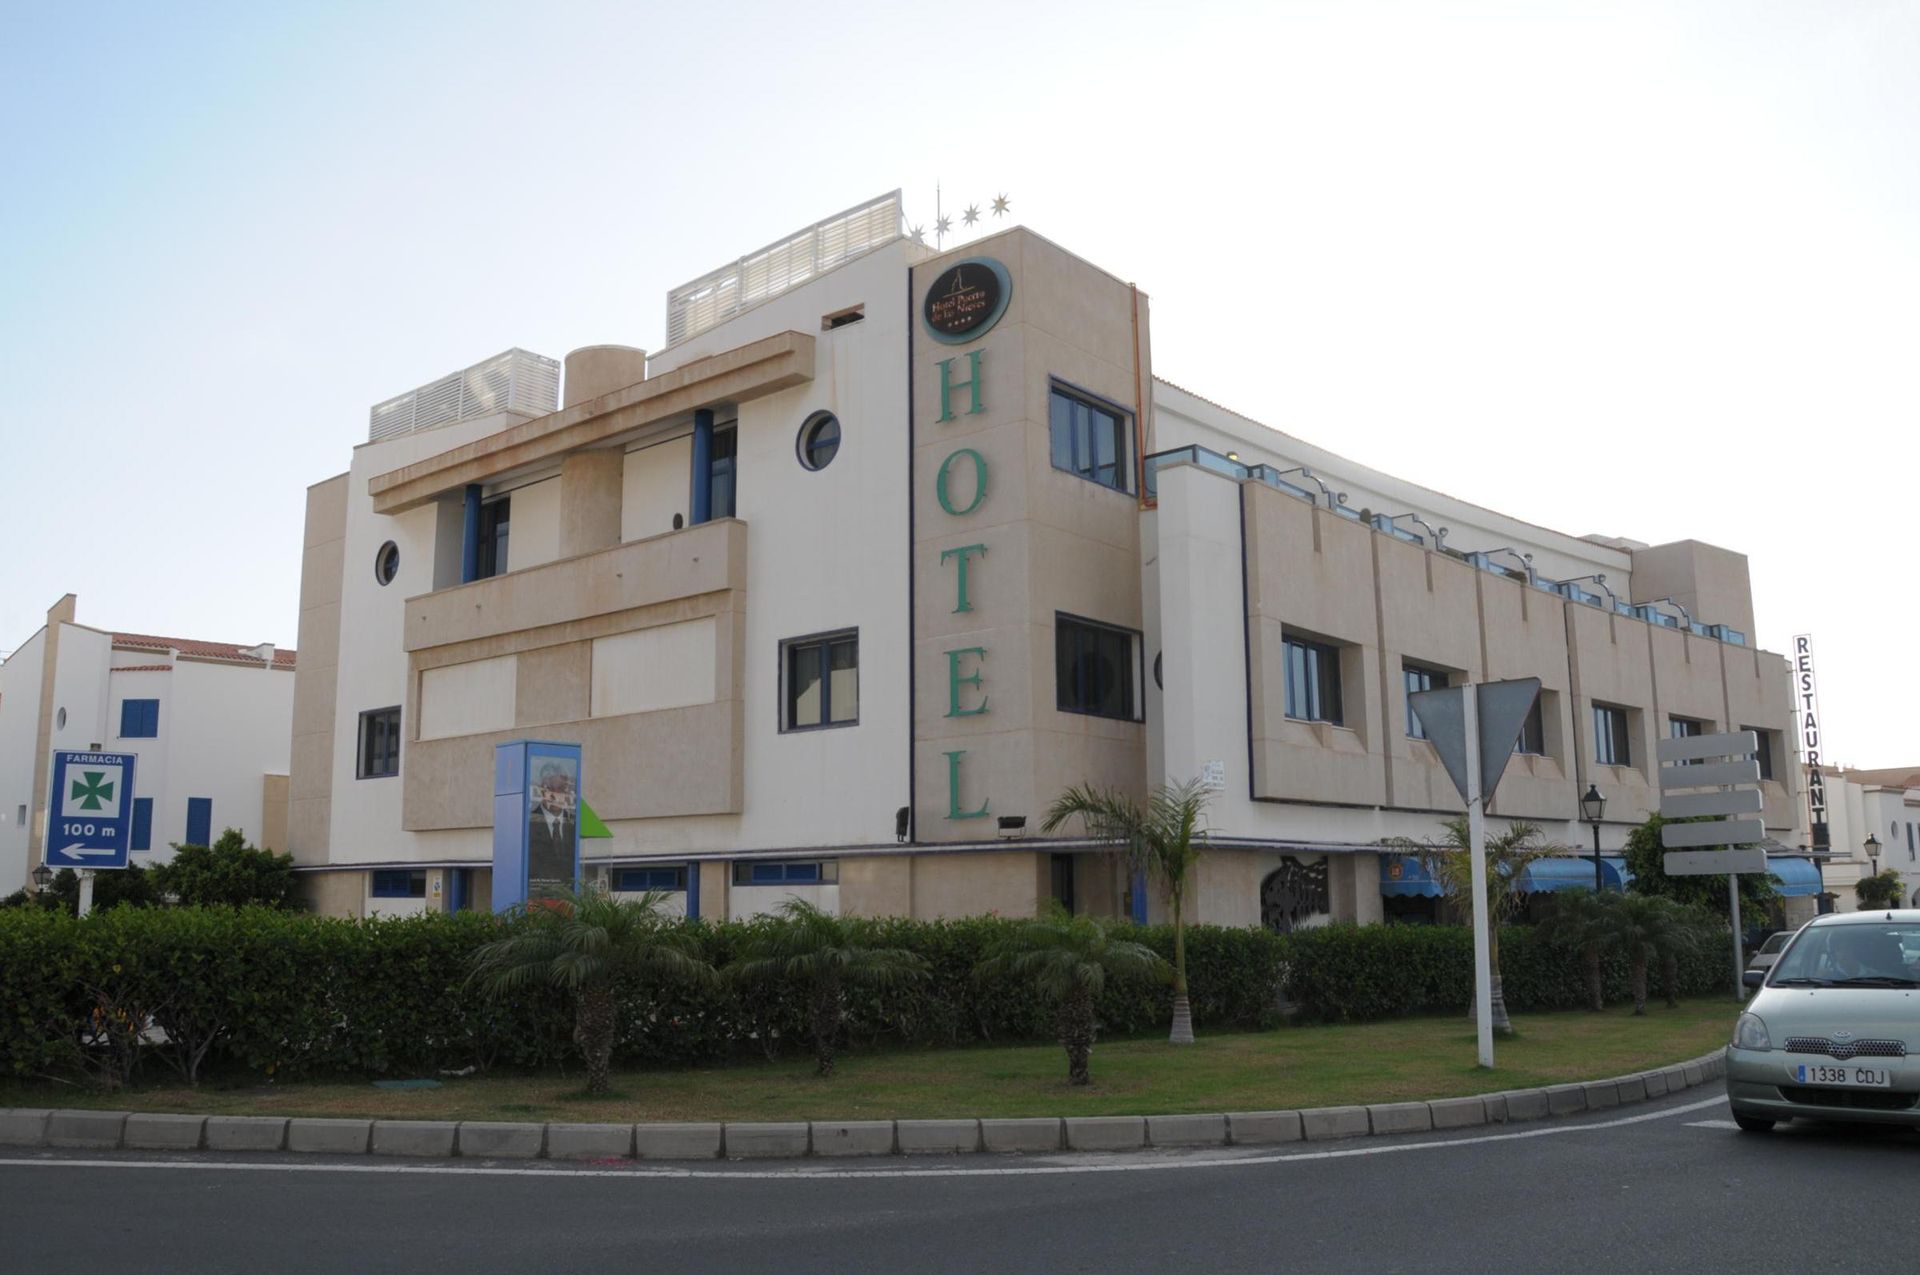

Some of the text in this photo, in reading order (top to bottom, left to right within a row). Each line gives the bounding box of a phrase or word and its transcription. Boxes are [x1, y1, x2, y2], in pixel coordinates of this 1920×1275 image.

[935, 348, 989, 820] HOTEL
[66, 754, 123, 765] FARMACIA
[63, 823, 115, 836] 100 m
[1811, 1067, 1884, 1084] 1338 CDJ
